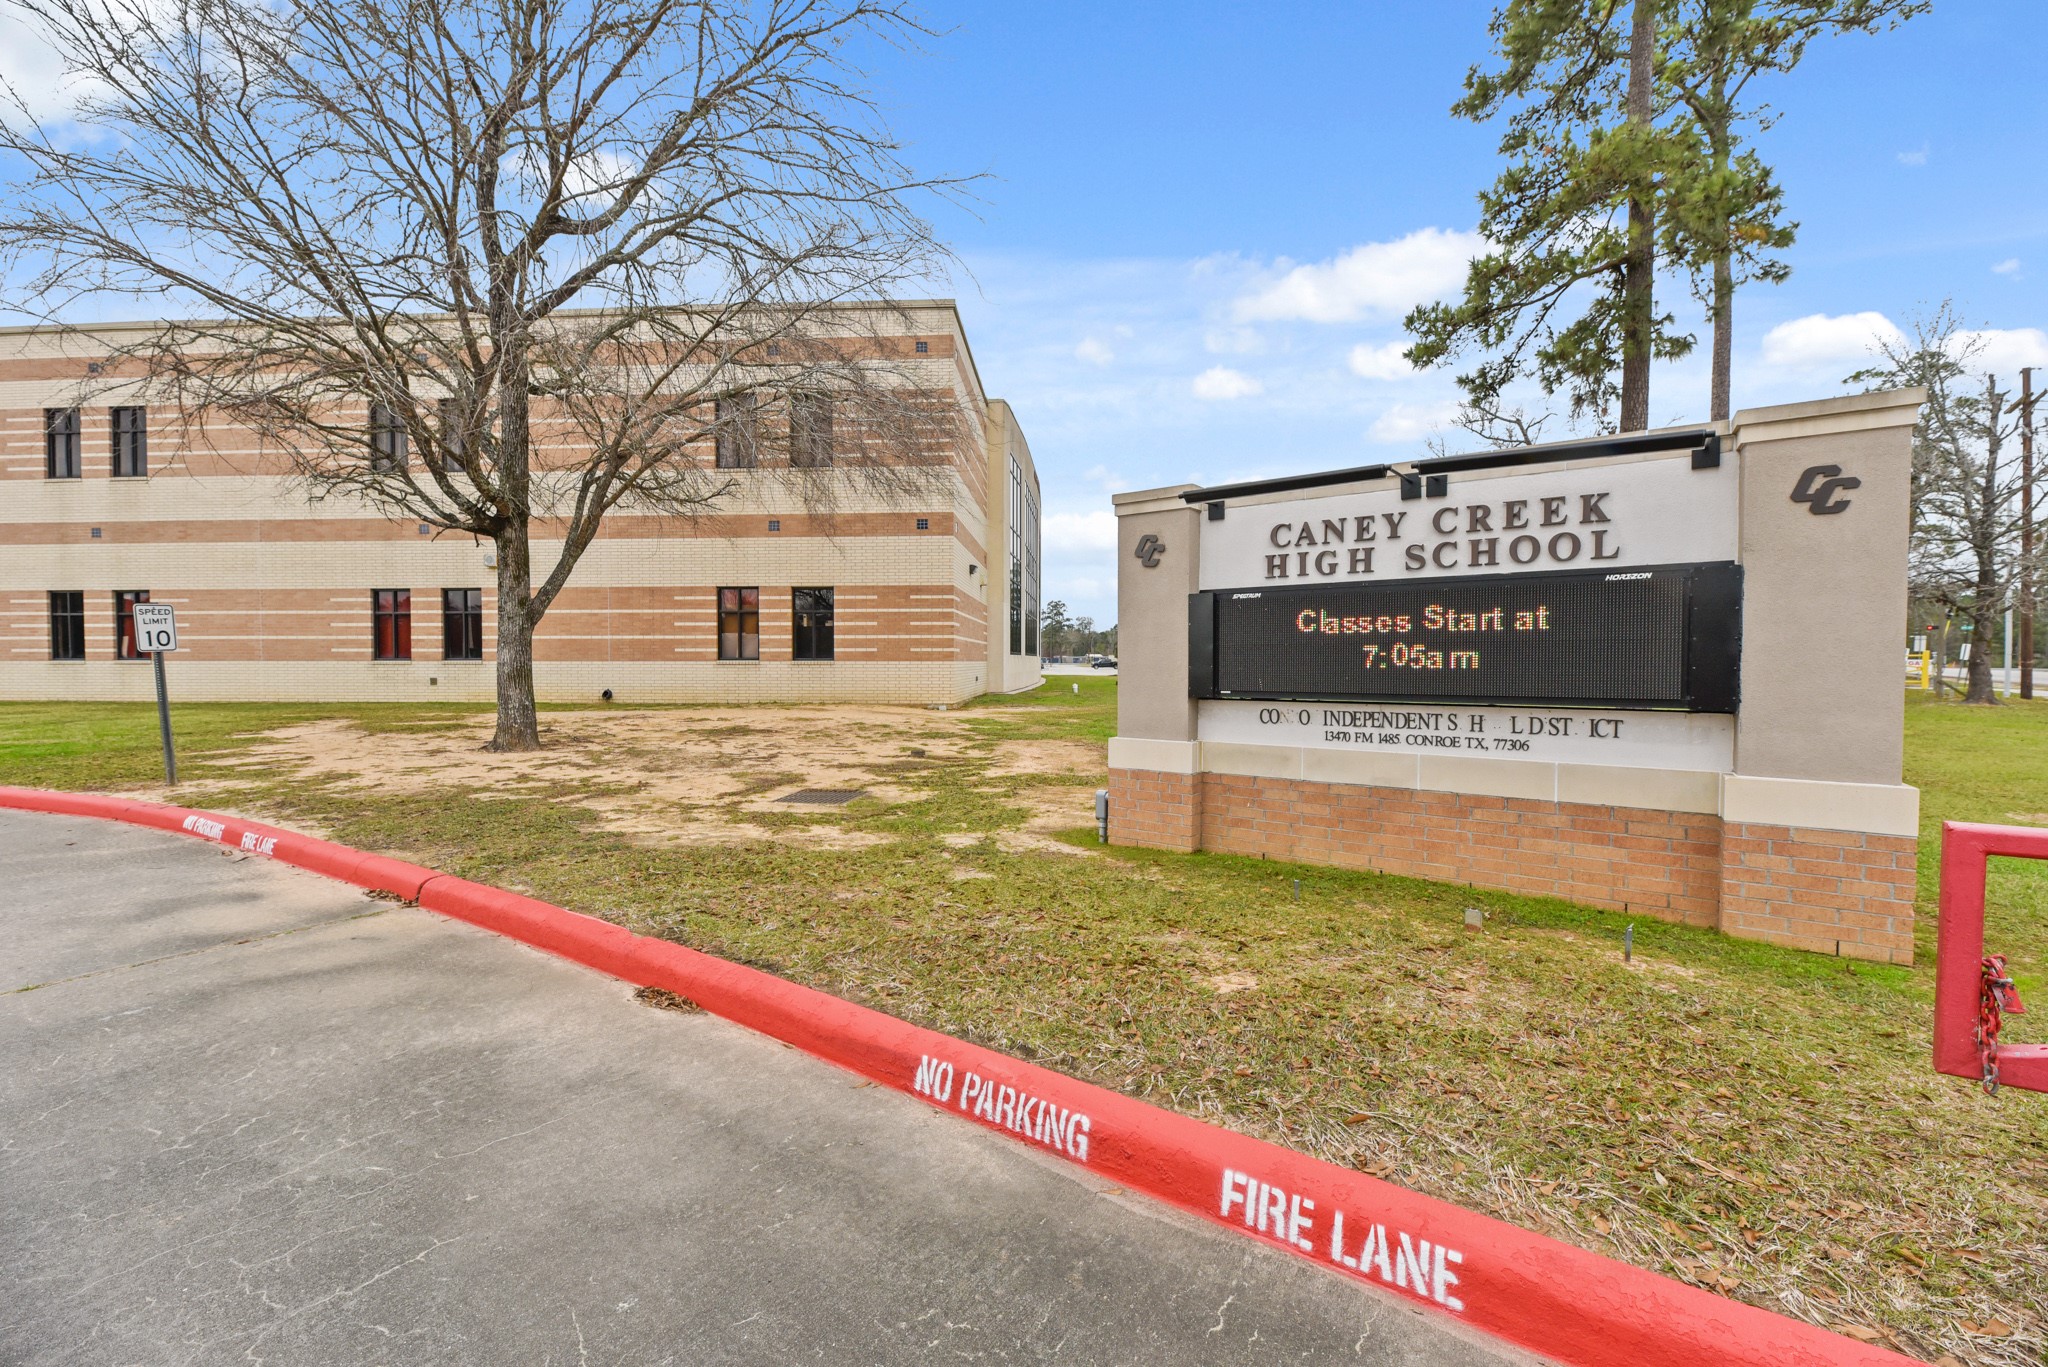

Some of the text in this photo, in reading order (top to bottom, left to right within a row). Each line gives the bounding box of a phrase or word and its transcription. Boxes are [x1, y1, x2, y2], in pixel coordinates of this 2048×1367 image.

[1270, 492, 1612, 548] CANEY CREEK
[1264, 529, 1620, 579] HIGH SCHOOL
[1605, 571, 1653, 581] HORIZON
[138, 608, 171, 616] SPEED
[142, 617, 169, 625] LIMIT
[1296, 603, 1550, 634] Classes Start at
[145, 630, 171, 647] 10
[1323, 710, 1443, 731] INDEPENDENT
[1528, 715, 1624, 739] DSTICT
[1324, 730, 1350, 743] 13470
[1354, 732, 1374, 744] FM
[1405, 734, 1461, 749] CONROE
[1465, 737, 1489, 751] TX,
[1493, 738, 1530, 751] 77306
[914, 1055, 1092, 1163] NO PARKING
[1219, 1168, 1465, 1312] FIRE LANE
